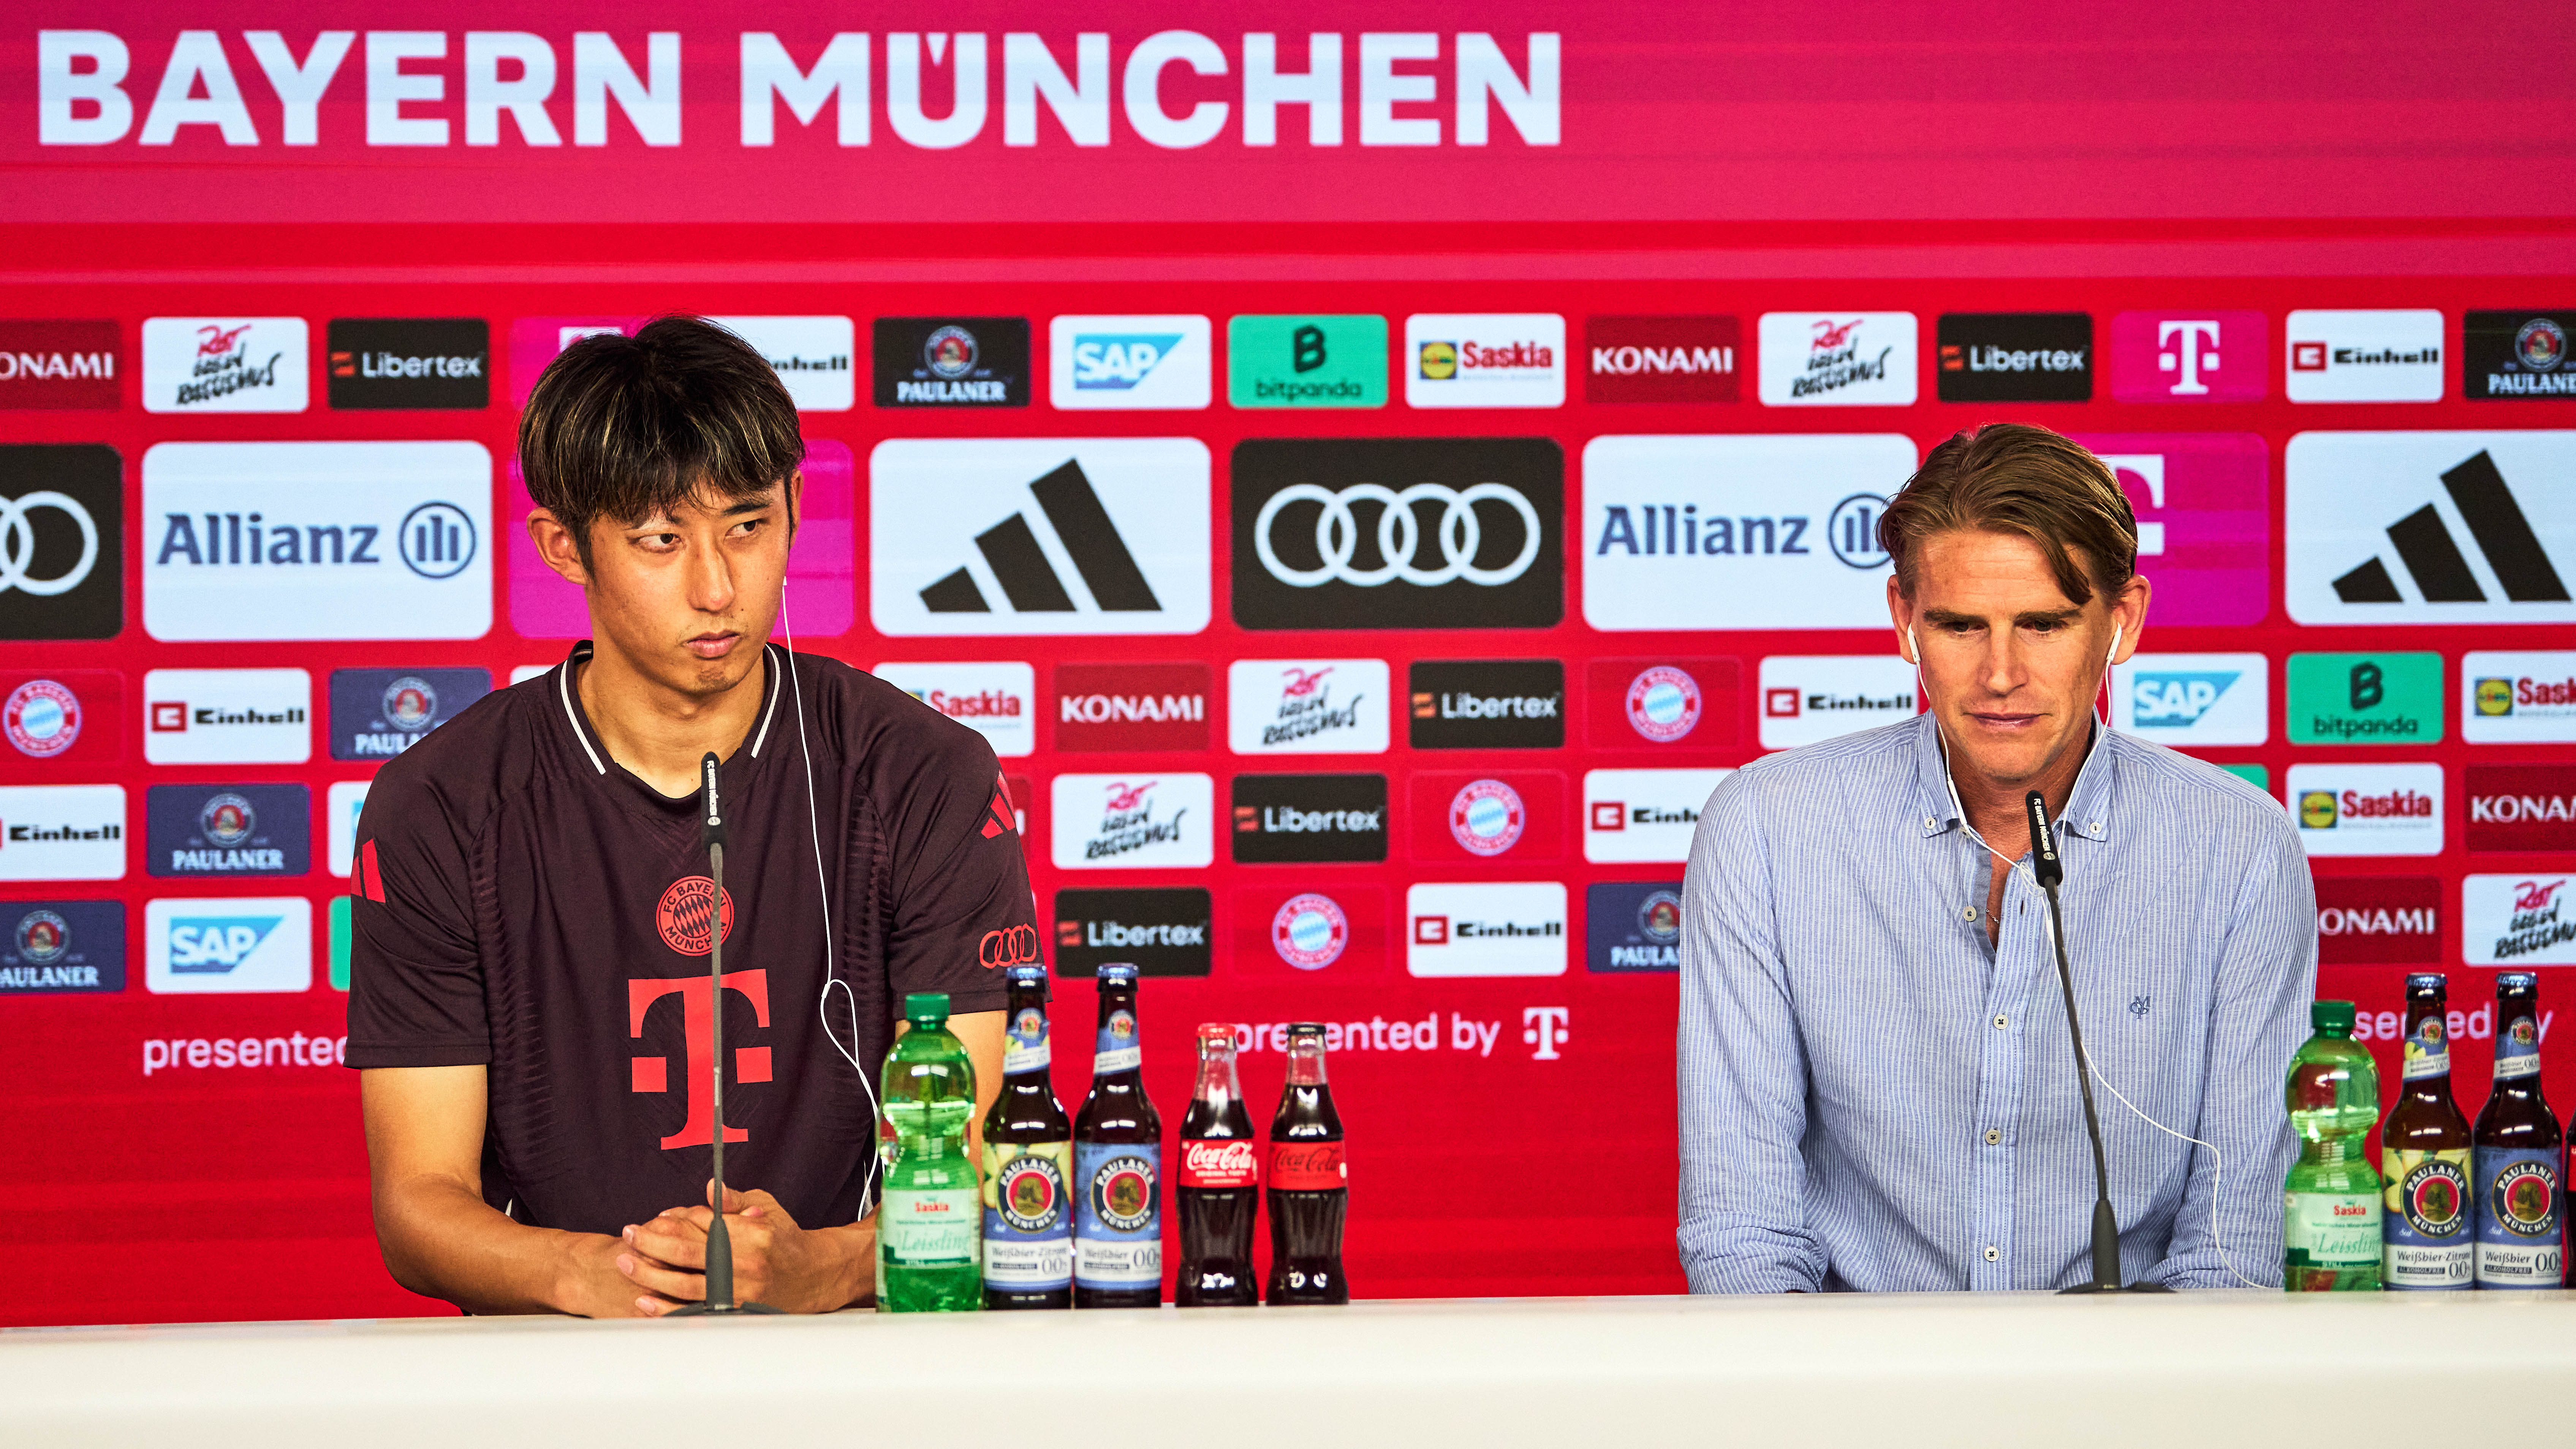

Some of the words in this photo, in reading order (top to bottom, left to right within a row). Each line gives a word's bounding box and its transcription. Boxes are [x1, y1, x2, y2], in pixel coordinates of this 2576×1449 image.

[39, 30, 681, 146] BAYERN
[741, 30, 1560, 149] MÜNCHEN
[0, 353, 112, 378] ONAMI
[363, 353, 480, 377] Libertex
[772, 354, 848, 371] nhell
[1074, 341, 1161, 382] SAP
[1463, 342, 1552, 368] Saskia
[1593, 347, 1732, 373] KONAMI
[1971, 347, 2083, 371] Libertex
[2334, 349, 2438, 364] Einhell
[897, 381, 1007, 403] PAULANER
[1256, 380, 1362, 401] bitpanda
[2487, 372, 2576, 395] PAULANE
[157, 513, 379, 565] Allianz
[1598, 505, 1809, 555] Allianz
[1808, 696, 1911, 710] Einhell
[2135, 680, 2216, 720] SAP
[2517, 677, 2576, 706] Sask
[930, 691, 1021, 717] Saskia
[1062, 695, 1203, 722] KONAMI
[1442, 693, 1556, 718] Libertex
[195, 709, 304, 724] Einhell
[2314, 716, 2418, 739] bitpanda
[355, 733, 417, 754] PAULA
[1633, 805, 1696, 824] Einh
[2035, 805, 2046, 825] BAYERN
[2342, 791, 2432, 817] Saskia
[2471, 794, 2576, 821] KONA
[1265, 808, 1379, 832] Libertex
[9, 826, 120, 841] Einhell
[2040, 826, 2049, 851] MÜNCHEN
[172, 850, 284, 871] PAULANER
[663, 896, 676, 913] FC
[676, 882, 726, 906] BAYEN
[1457, 922, 1561, 937] Einhell
[2317, 907, 2435, 935] ONAMI
[665, 921, 726, 950] MÜNCHN
[1088, 922, 1203, 946] Libertex
[171, 926, 255, 967] SAP
[1609, 944, 1680, 968] PAULA
[0, 967, 101, 988] AULANER
[1235, 1012, 1438, 1054] preented
[1453, 1013, 1500, 1056] by
[2406, 1165, 2464, 1191] PAULANER
[2497, 1164, 2556, 1190] PAULANER
[2334, 1204, 2367, 1216] Saskia
[2485, 1251, 2531, 1266] Weißbier
